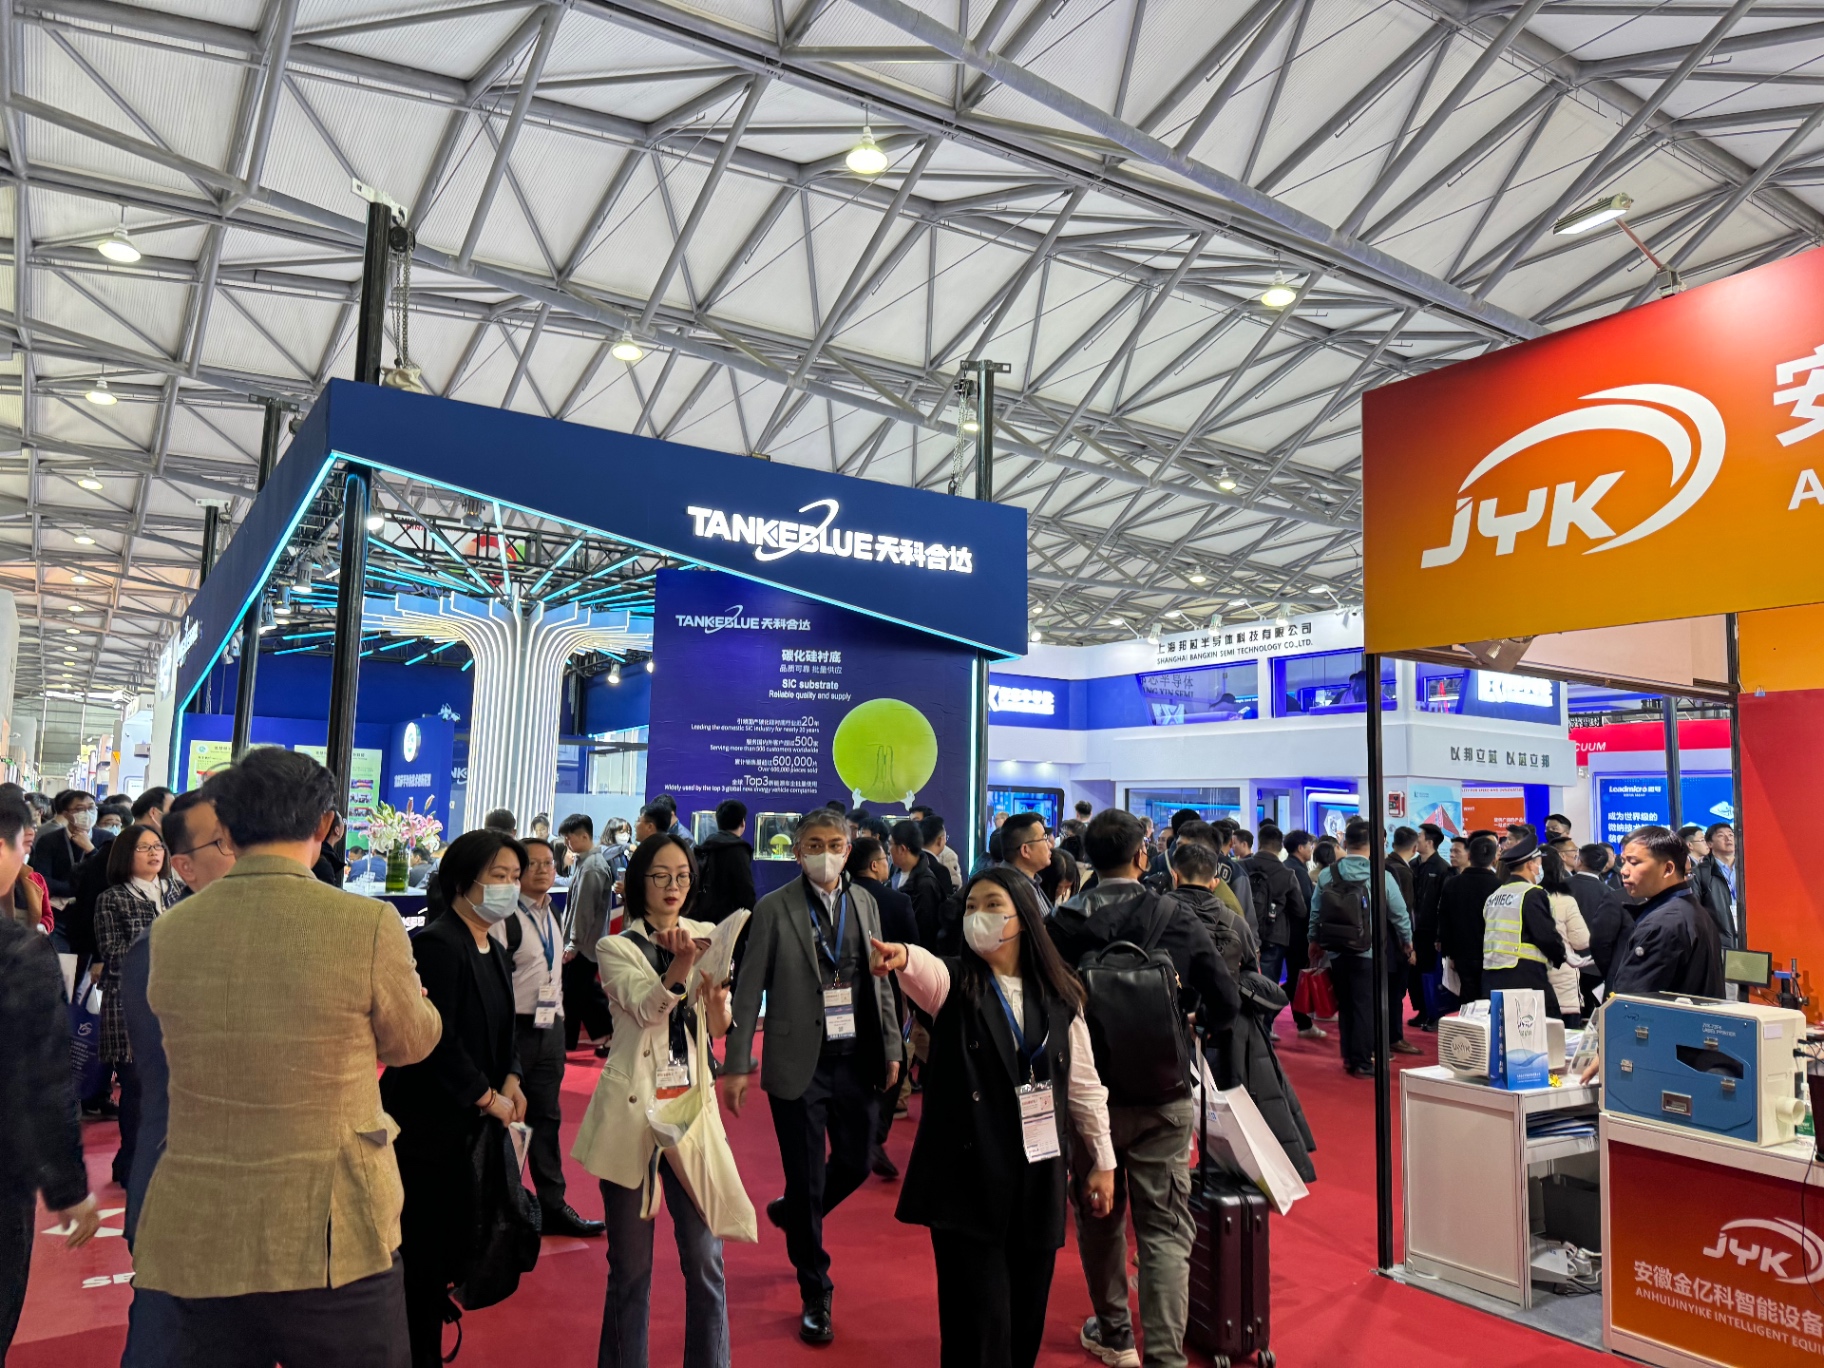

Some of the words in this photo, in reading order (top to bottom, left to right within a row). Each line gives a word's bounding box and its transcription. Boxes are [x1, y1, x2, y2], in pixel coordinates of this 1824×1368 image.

[1421, 471, 1627, 568] JYK
[687, 500, 875, 561] TANKEBLUE
[875, 534, 973, 574] 天科合达
[676, 605, 759, 634] TANKEBLUE
[761, 617, 811, 631] 天科合达
[1157, 622, 1312, 655] 上海邦芯半导体科技有限公司
[781, 649, 842, 664] 碳化硅衬底
[1157, 654, 1188, 665] SHANGHAI
[1220, 648, 1235, 658] SEMI
[1237, 642, 1282, 656] TECHNOLOGY
[779, 664, 810, 673] 品质可靠
[812, 665, 842, 674] 批量供应
[768, 690, 794, 698] Reliable
[796, 691, 816, 700] quality
[830, 692, 852, 702] supply
[782, 678, 796, 688] SiC
[799, 680, 839, 690] substrate
[691, 724, 711, 732] Leading
[1703, 1233, 1793, 1279] JYK
[1634, 1260, 1824, 1338] 安徽金亿科智能设备
[1636, 1286, 1712, 1320] ANHUIJINYIKE
[1714, 1310, 1789, 1344] INTELLIGENT
